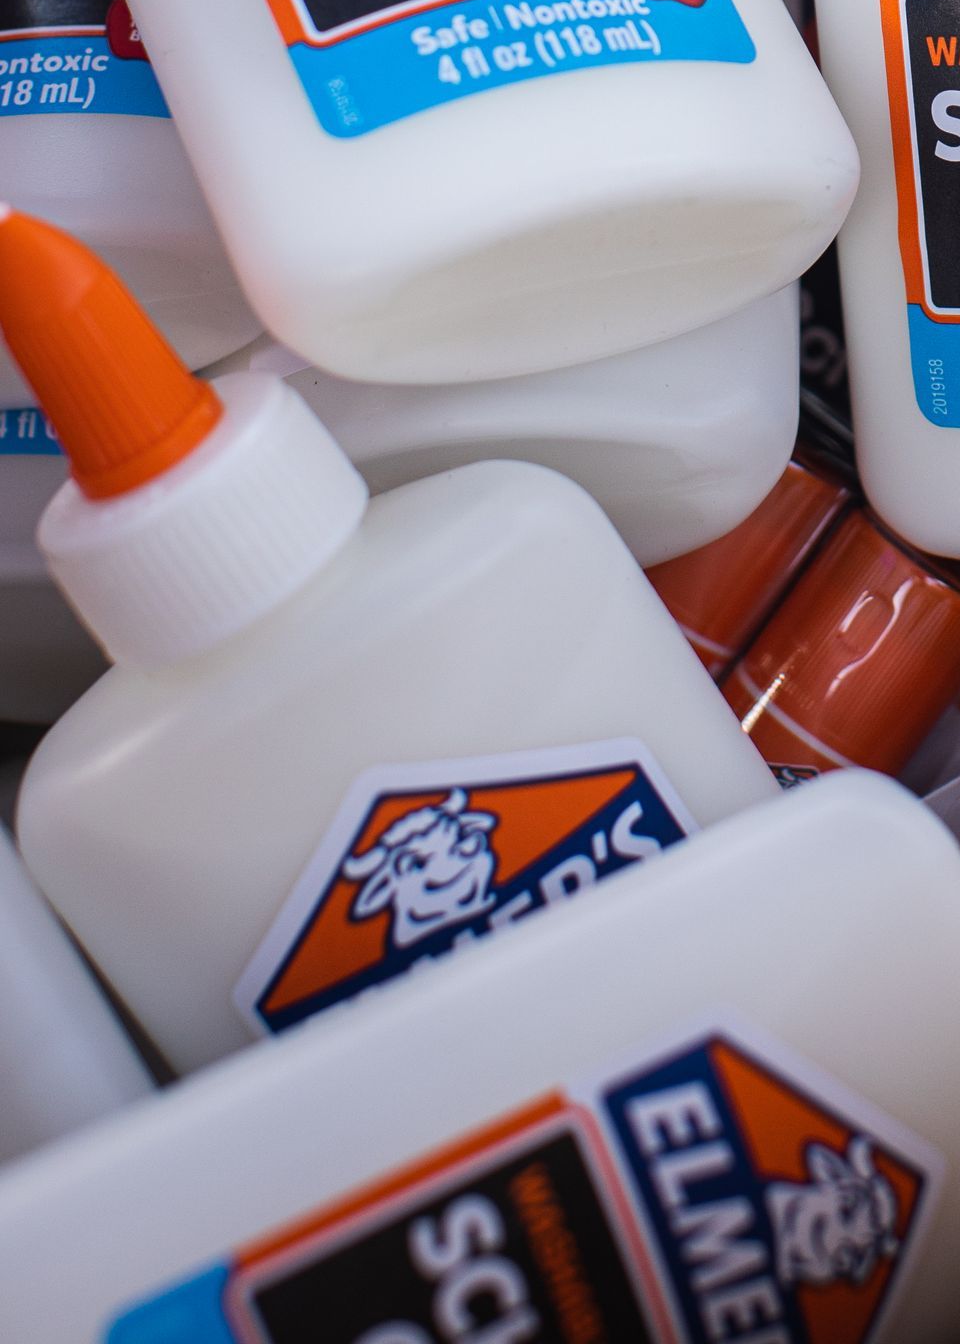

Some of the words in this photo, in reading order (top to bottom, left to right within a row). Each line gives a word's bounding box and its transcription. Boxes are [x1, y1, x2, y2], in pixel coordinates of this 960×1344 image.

[411, 13, 489, 56] Safe
[438, 55, 461, 85] 4
[461, 44, 491, 79] fl
[493, 40, 533, 72] oz
[533, 23, 603, 68] (118
[602, 18, 662, 56] mL)
[40, 77, 96, 109] mL)
[928, 359, 948, 415] 2019158
[624, 1079, 796, 1344] ELME
